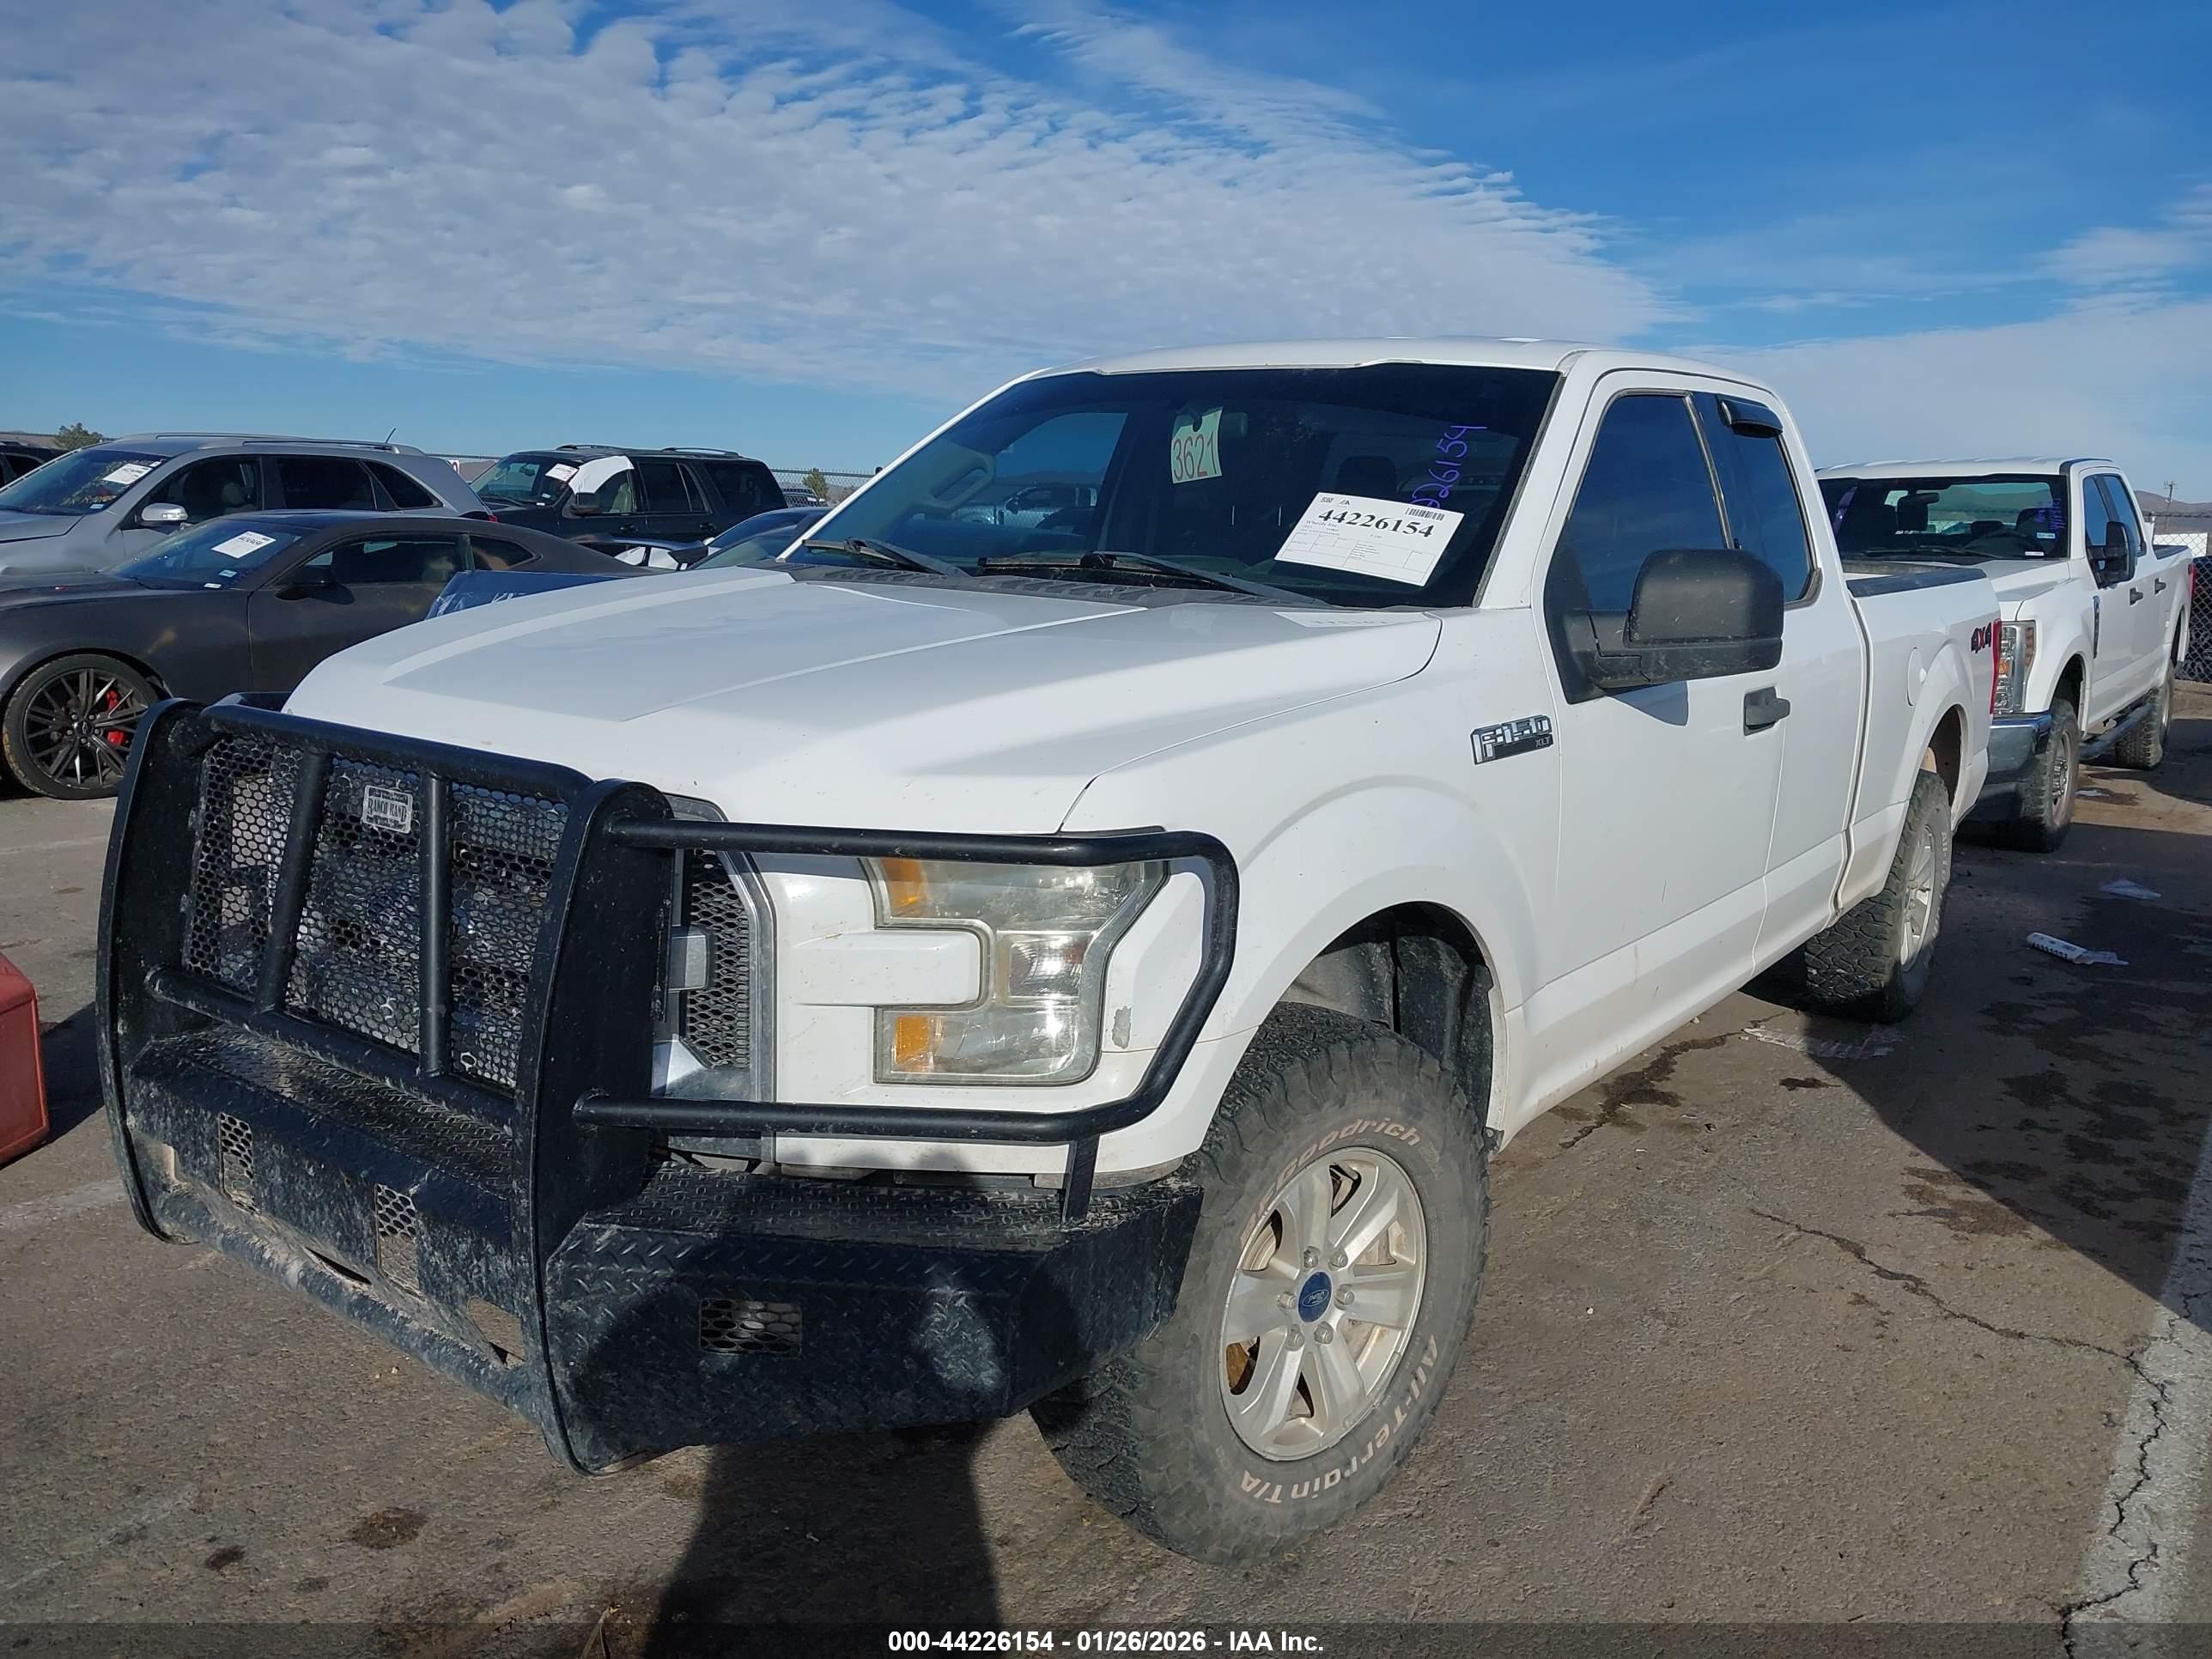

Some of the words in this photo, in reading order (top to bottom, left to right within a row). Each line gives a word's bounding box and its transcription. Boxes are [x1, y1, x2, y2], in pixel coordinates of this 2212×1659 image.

[1173, 431, 1218, 481] 3621
[1318, 508, 1437, 538] 44226154
[1534, 736, 1551, 748] XLT
[1290, 1334, 1439, 1500] All-Terrain
[1240, 1469, 1283, 1504] T/A
